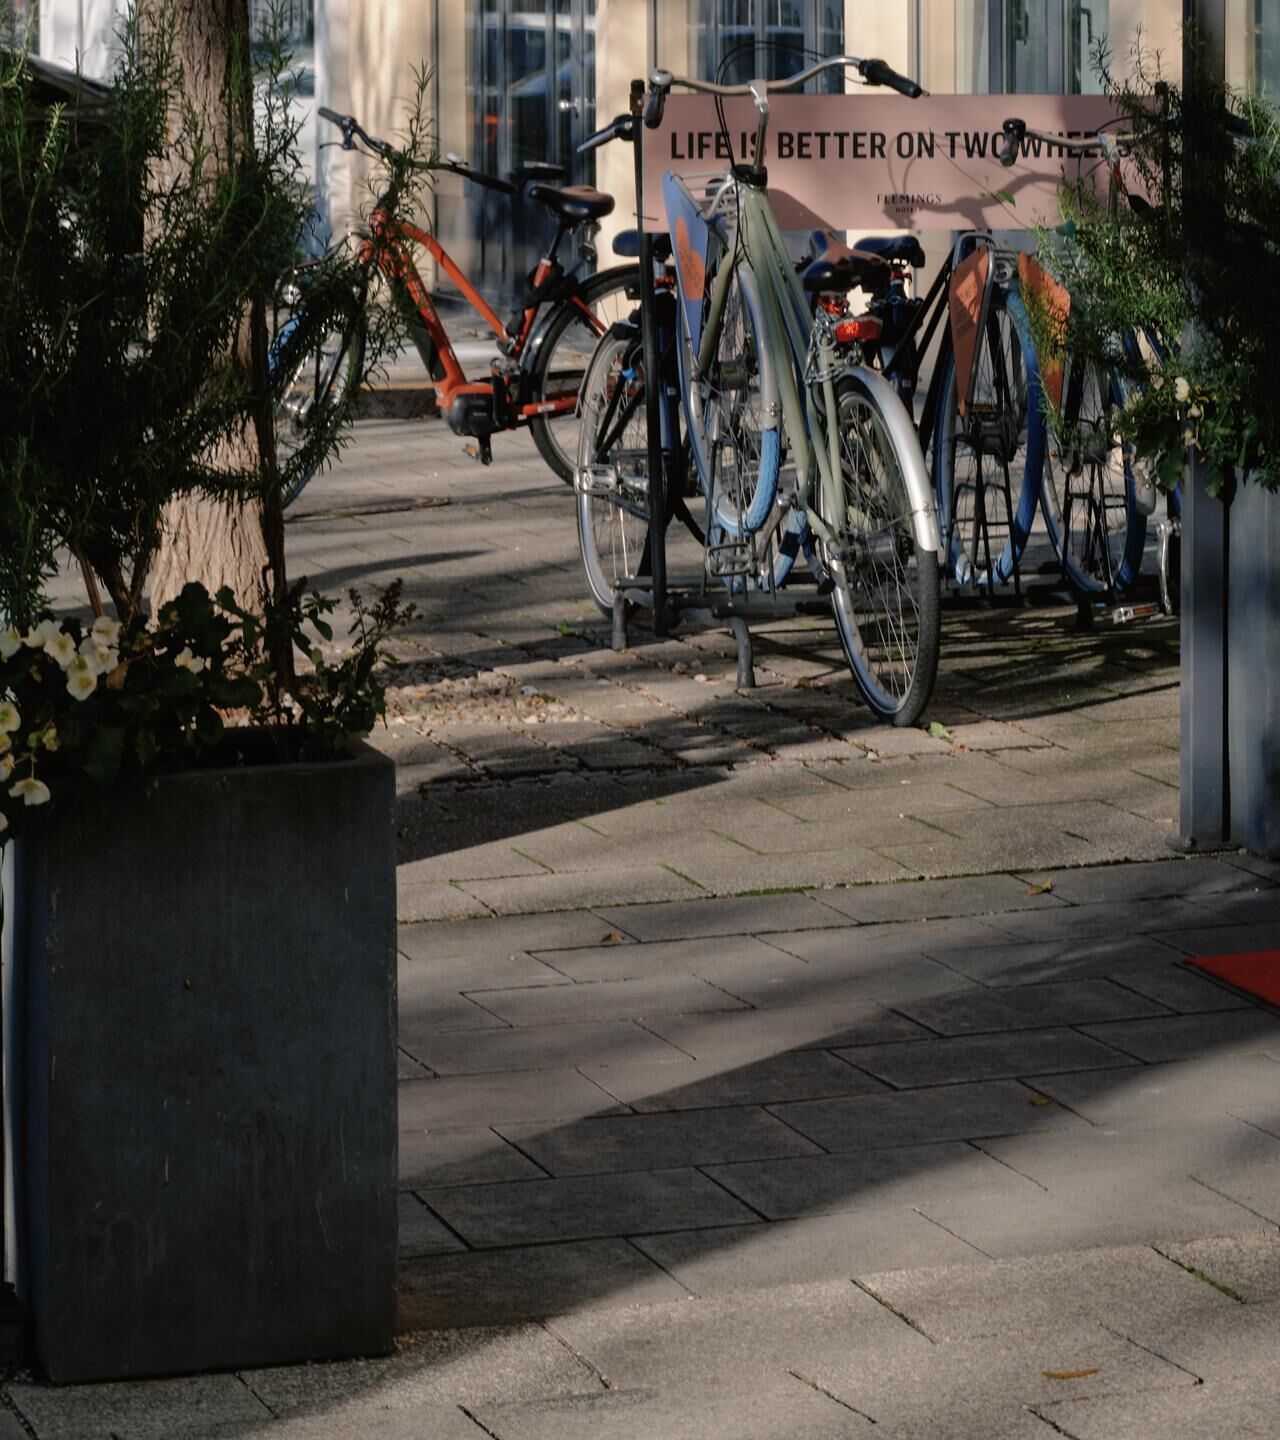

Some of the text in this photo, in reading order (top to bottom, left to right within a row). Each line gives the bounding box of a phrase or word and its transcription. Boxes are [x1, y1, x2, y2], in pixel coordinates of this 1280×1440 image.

[670, 131, 731, 160] LIFE
[777, 131, 887, 160] BETTER
[896, 131, 935, 159] ON
[876, 193, 942, 205] FLEMINGS
